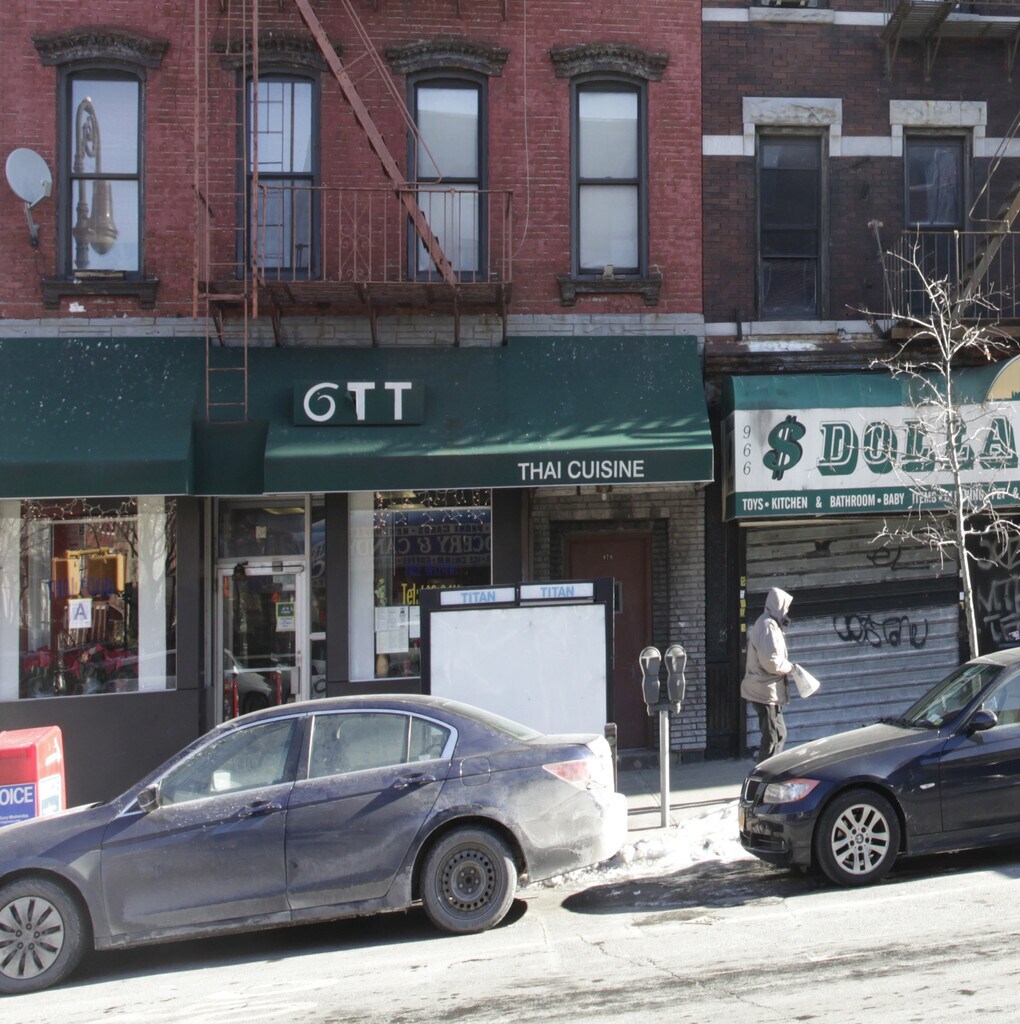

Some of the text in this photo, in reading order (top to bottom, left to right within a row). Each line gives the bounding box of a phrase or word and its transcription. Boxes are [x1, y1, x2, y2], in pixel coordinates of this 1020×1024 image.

[518, 459, 645, 480] THAI CUISINE
[742, 498, 764, 511] TOYS
[772, 496, 808, 510] KITCHEN
[816, 496, 822, 508] &
[830, 494, 876, 508] BATHROOM
[883, 493, 905, 506] BABY
[912, 490, 937, 505] ITEMS
[461, 591, 496, 604] TITAN
[540, 586, 575, 598] TITAN
[73, 603, 87, 620] A
[0, 786, 34, 806] OICE
